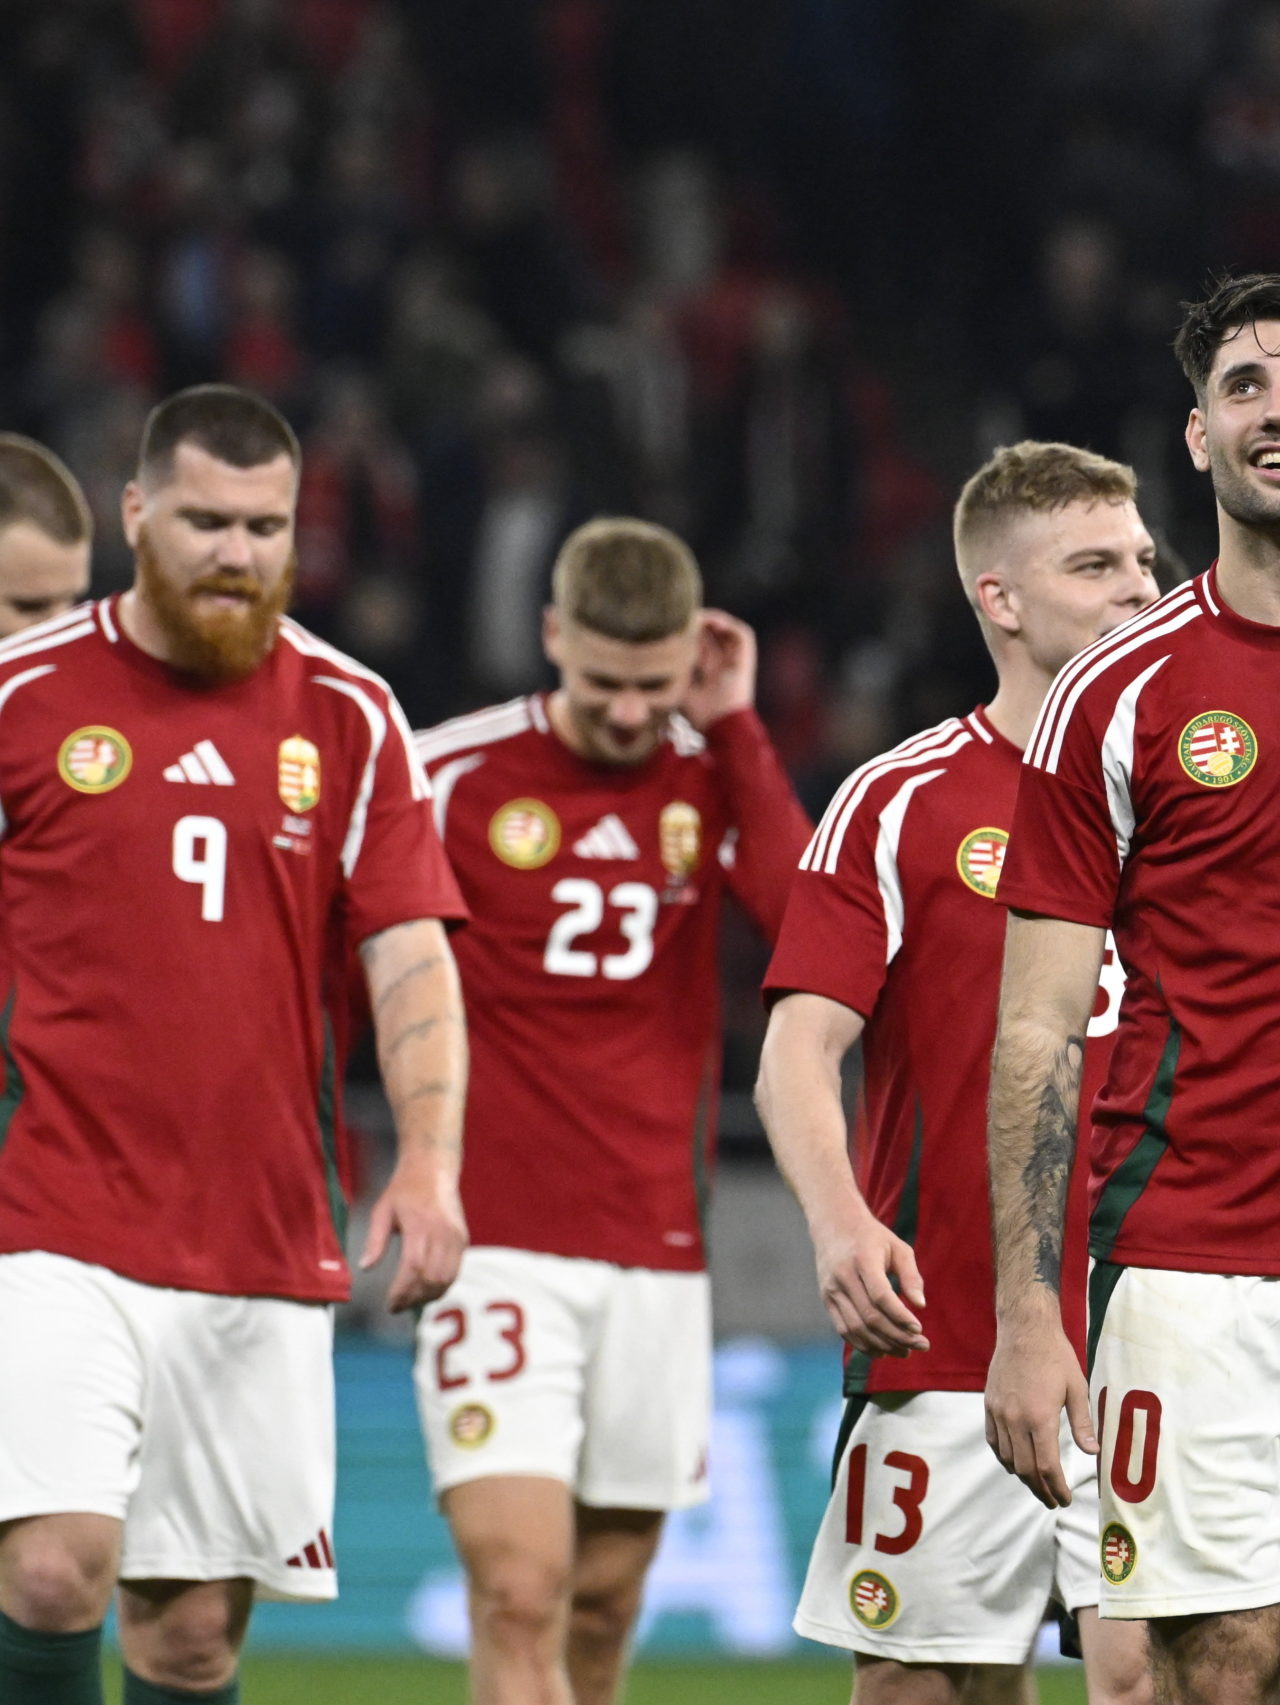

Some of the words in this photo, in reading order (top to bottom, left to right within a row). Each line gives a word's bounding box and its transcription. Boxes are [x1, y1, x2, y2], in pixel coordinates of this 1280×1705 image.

[1212, 775, 1235, 784] 1901
[172, 815, 227, 922] 9
[543, 877, 658, 981] 23
[434, 1300, 527, 1391] 23
[845, 1443, 929, 1555] 13
